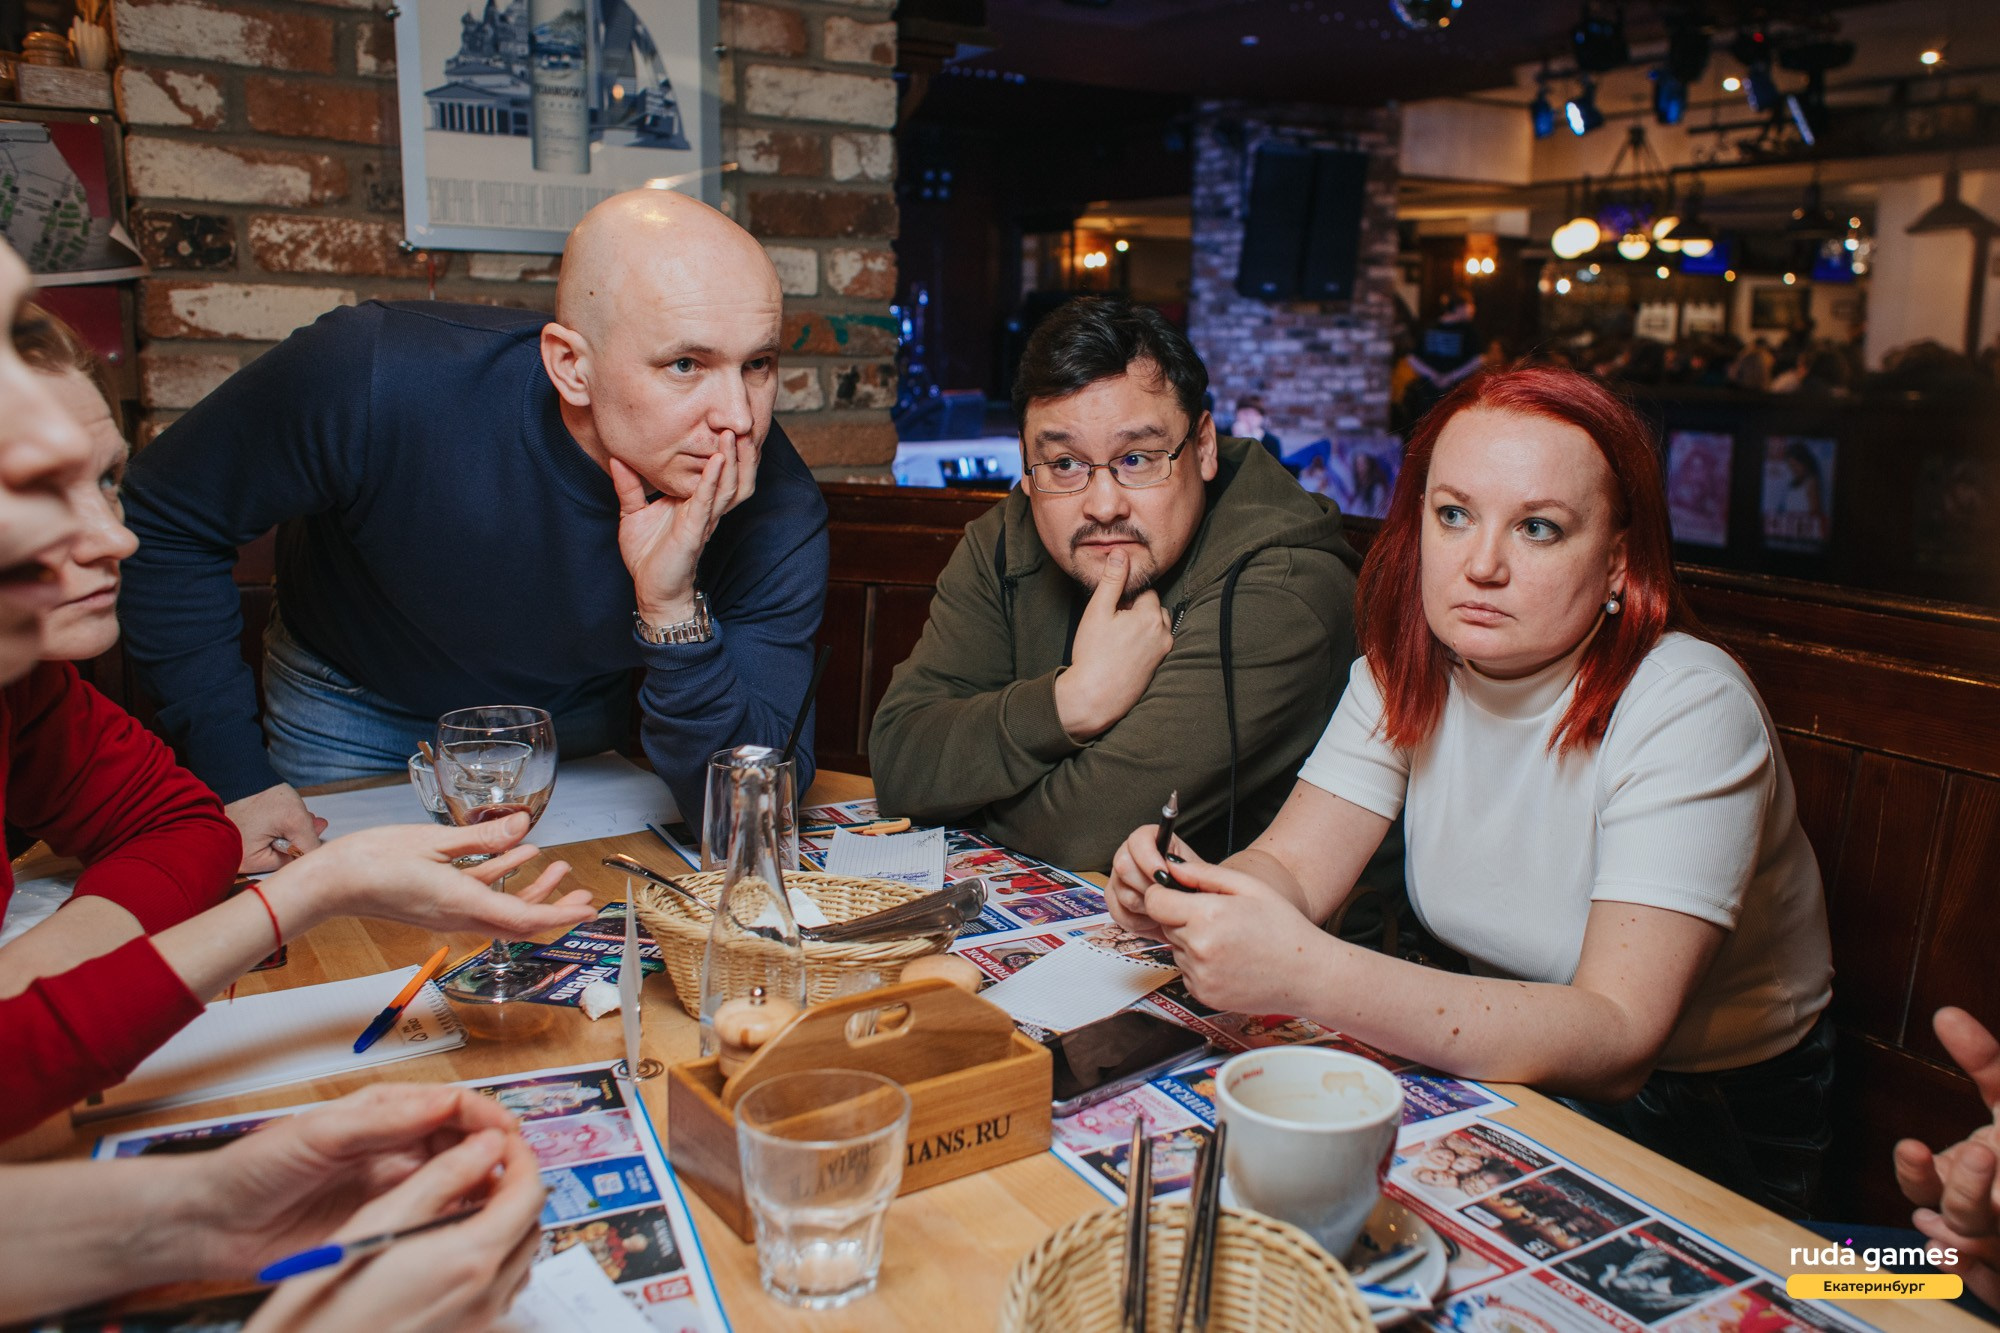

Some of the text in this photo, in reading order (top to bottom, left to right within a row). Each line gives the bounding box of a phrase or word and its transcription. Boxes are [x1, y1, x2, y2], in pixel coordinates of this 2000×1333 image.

[563, 939, 664, 959] Врбель
[1149, 993, 1239, 1049] MAXIMILIANS.RU
[1156, 1078, 1215, 1124] НИКАМ
[906, 1114, 1012, 1167] IANS.RU
